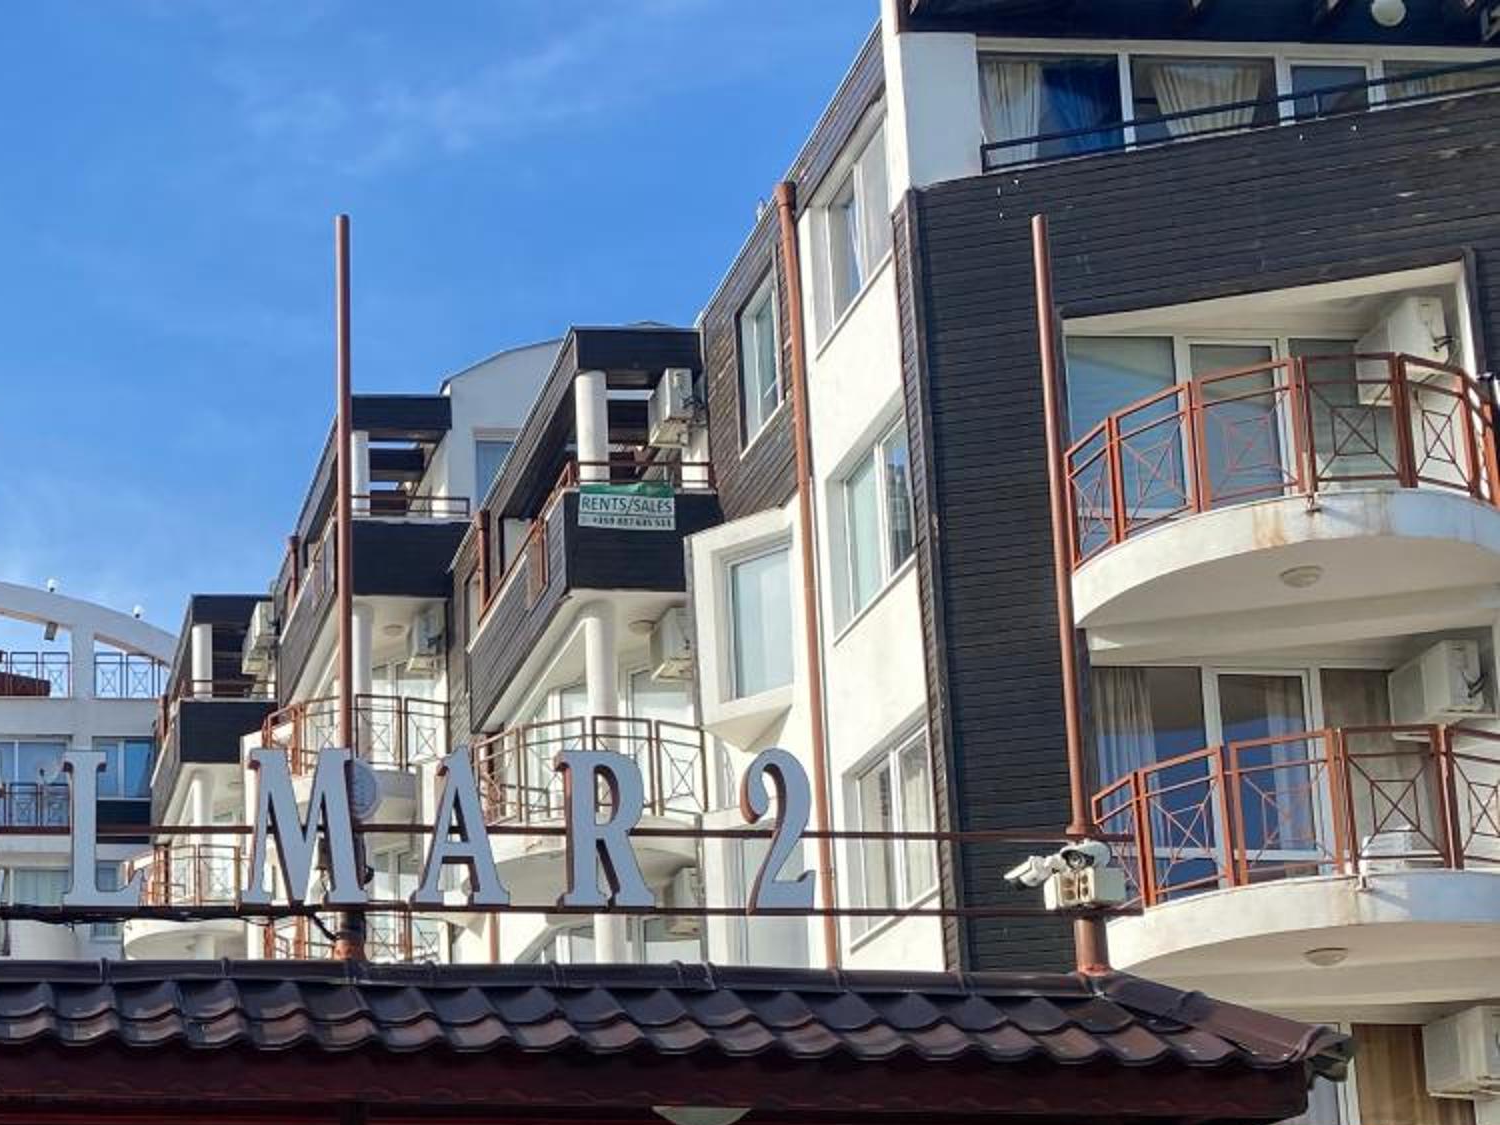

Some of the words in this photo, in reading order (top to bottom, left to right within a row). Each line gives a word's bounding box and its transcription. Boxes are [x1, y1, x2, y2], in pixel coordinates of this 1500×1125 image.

[581, 496, 672, 515] RENTS/SALES
[242, 745, 656, 910] MAR
[741, 748, 817, 910] 2
